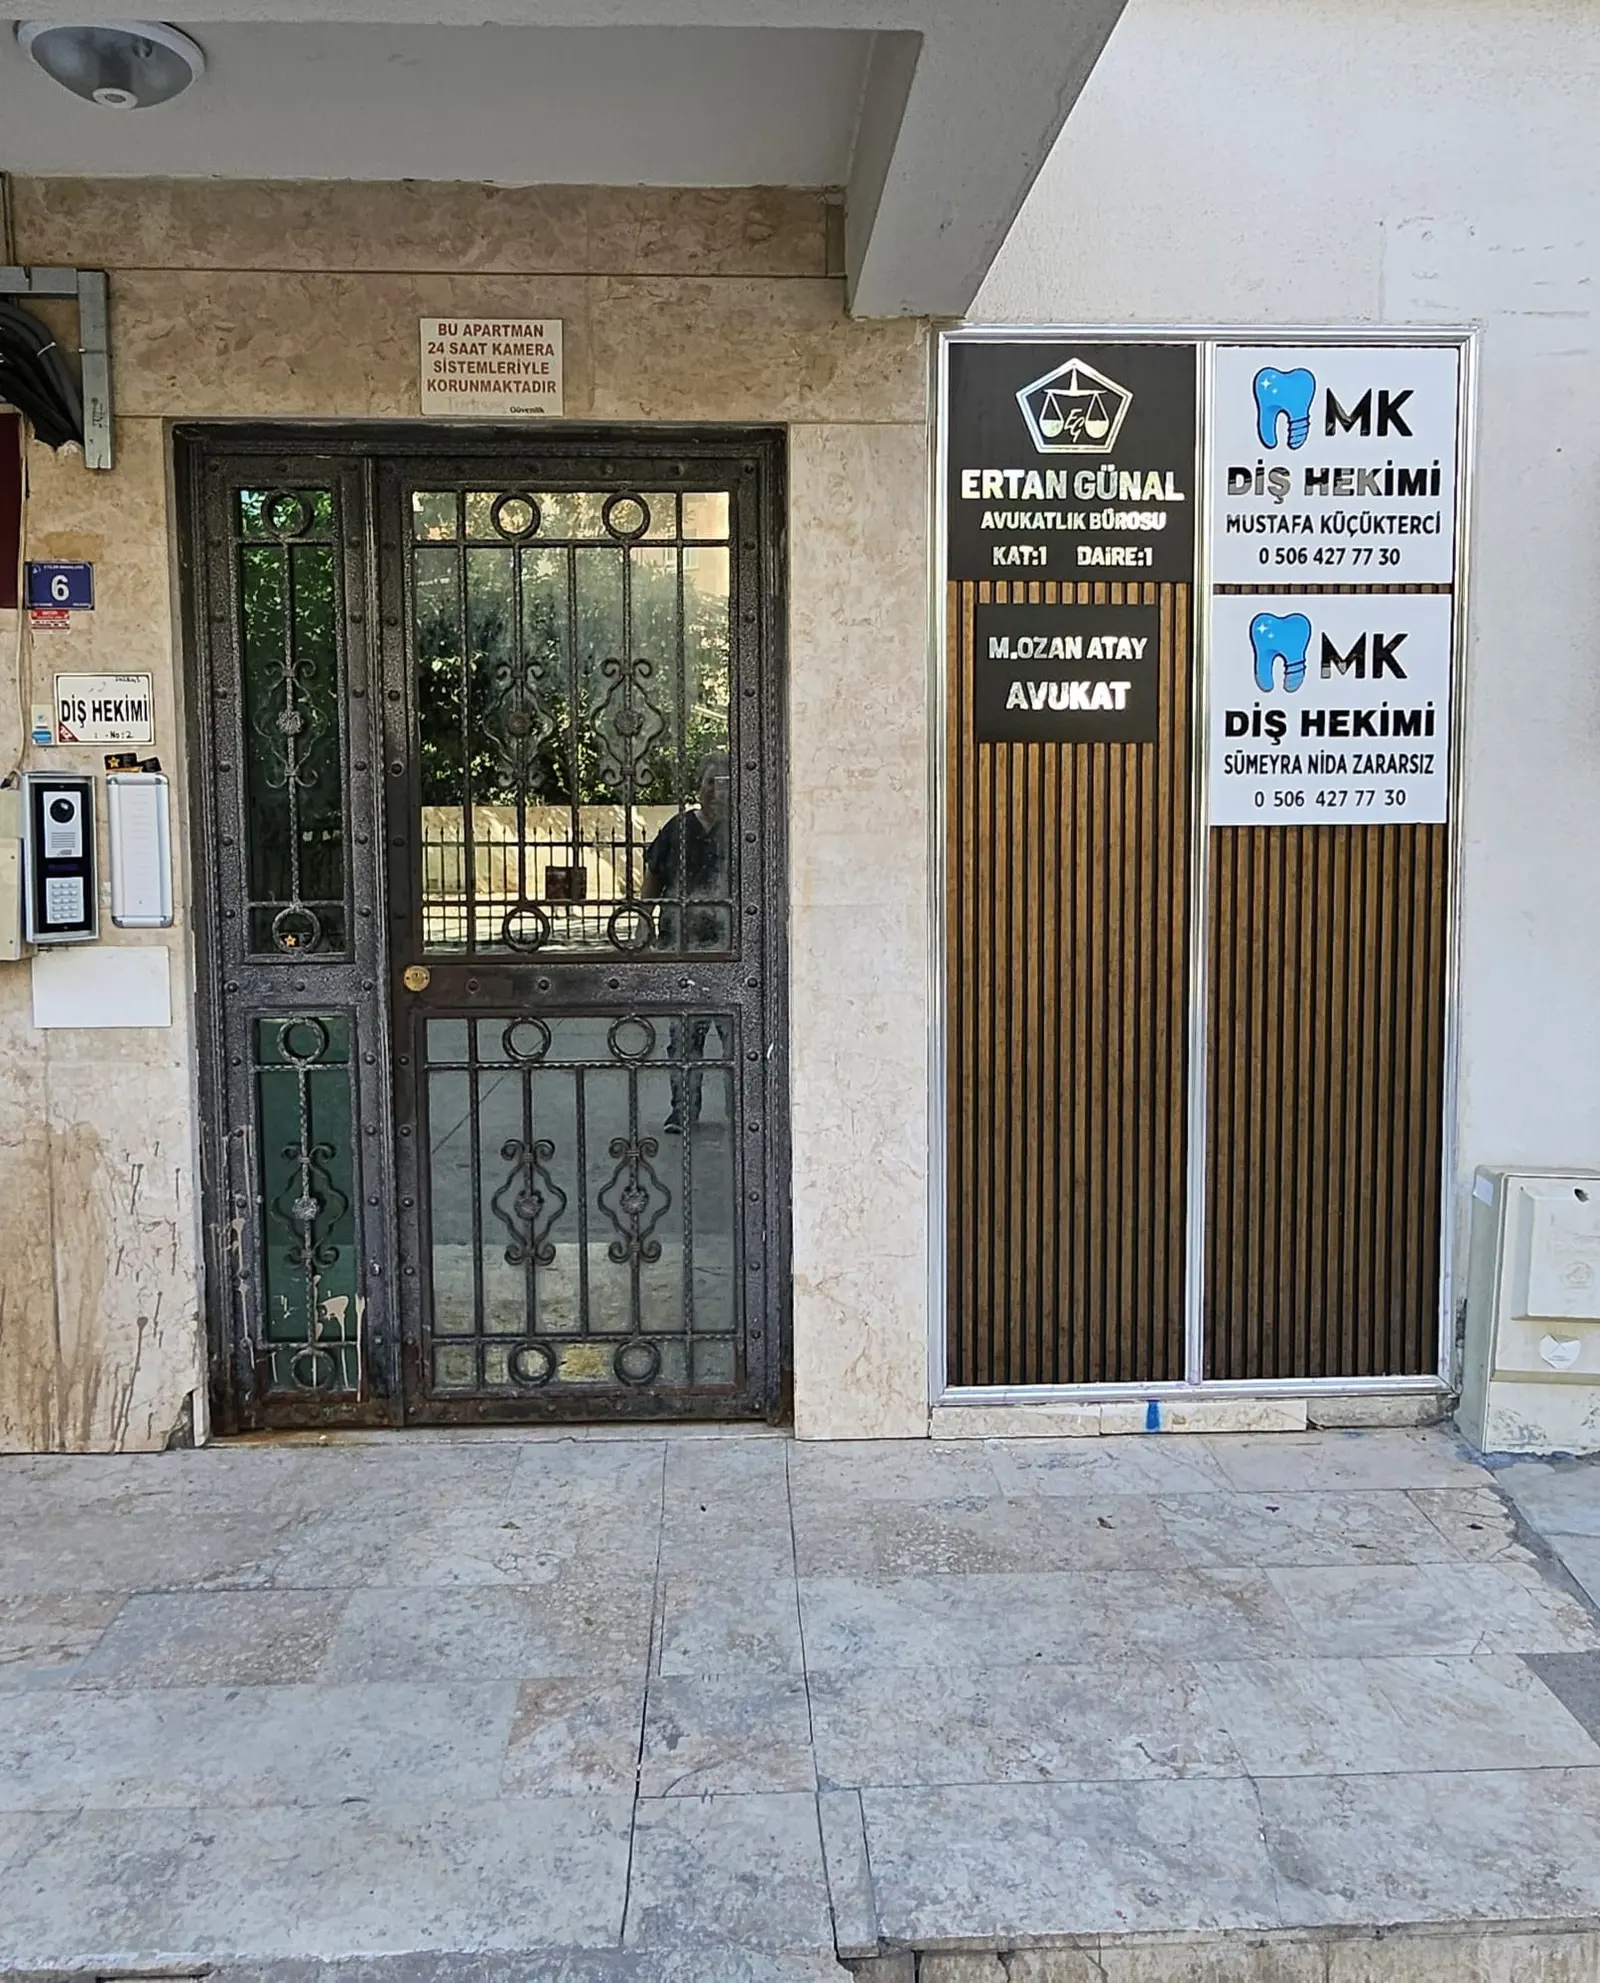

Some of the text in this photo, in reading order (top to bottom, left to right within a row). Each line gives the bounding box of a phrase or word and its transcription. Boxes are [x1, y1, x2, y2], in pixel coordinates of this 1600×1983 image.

[438, 323, 544, 337] BU APARTMAN
[428, 342, 555, 356] 24 SAAT KAMERA
[433, 357, 549, 374] SİSTEMLERİYLE
[427, 379, 556, 393] KORUNMAKTADIR
[1325, 387, 1414, 437] MK
[961, 464, 1185, 501] ERTAN GÜNAL
[1227, 459, 1441, 504] DİŞ HEKİMİ
[980, 508, 1167, 531] AVUKATLIK BÜROSU
[1226, 510, 1441, 538] MUSTAFA KÜÇÜKTERCİ
[992, 545, 1047, 566] KAT:1
[1259, 548, 1401, 565] 0 506 427 77 30
[51, 574, 70, 601] 6
[988, 636, 1148, 660] M.OZAN ATAY
[1321, 631, 1408, 679] MK
[1005, 681, 1132, 710] AVUKAT
[61, 694, 148, 728] DİŞ HEKİMİ
[1224, 701, 1436, 746] DİŞ HEKİMİ
[1224, 749, 1434, 775] SÜMEYRA NİDA ZARARSIZ
[1254, 790, 1406, 808] 0 506 427 77 30
